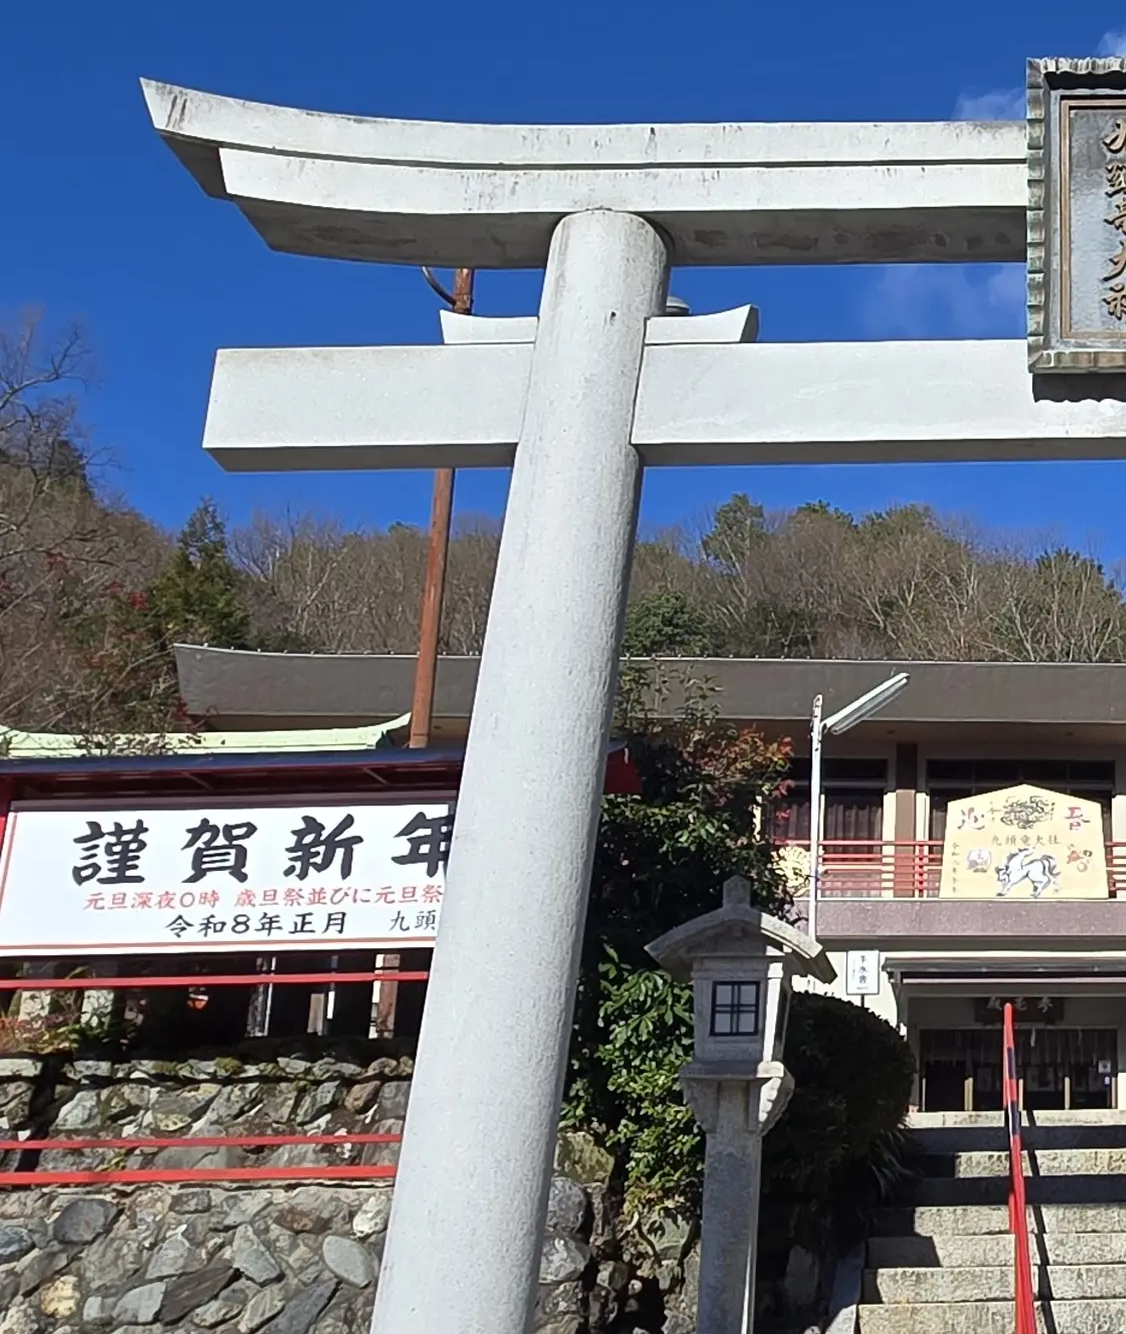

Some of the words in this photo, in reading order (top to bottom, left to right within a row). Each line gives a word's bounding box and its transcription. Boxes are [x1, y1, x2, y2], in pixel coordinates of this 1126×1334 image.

[72, 811, 455, 887] 謹賀新年
[233, 884, 444, 908] 歳旦祭並びに元旦祭
[164, 912, 347, 938] 令和8年正月
